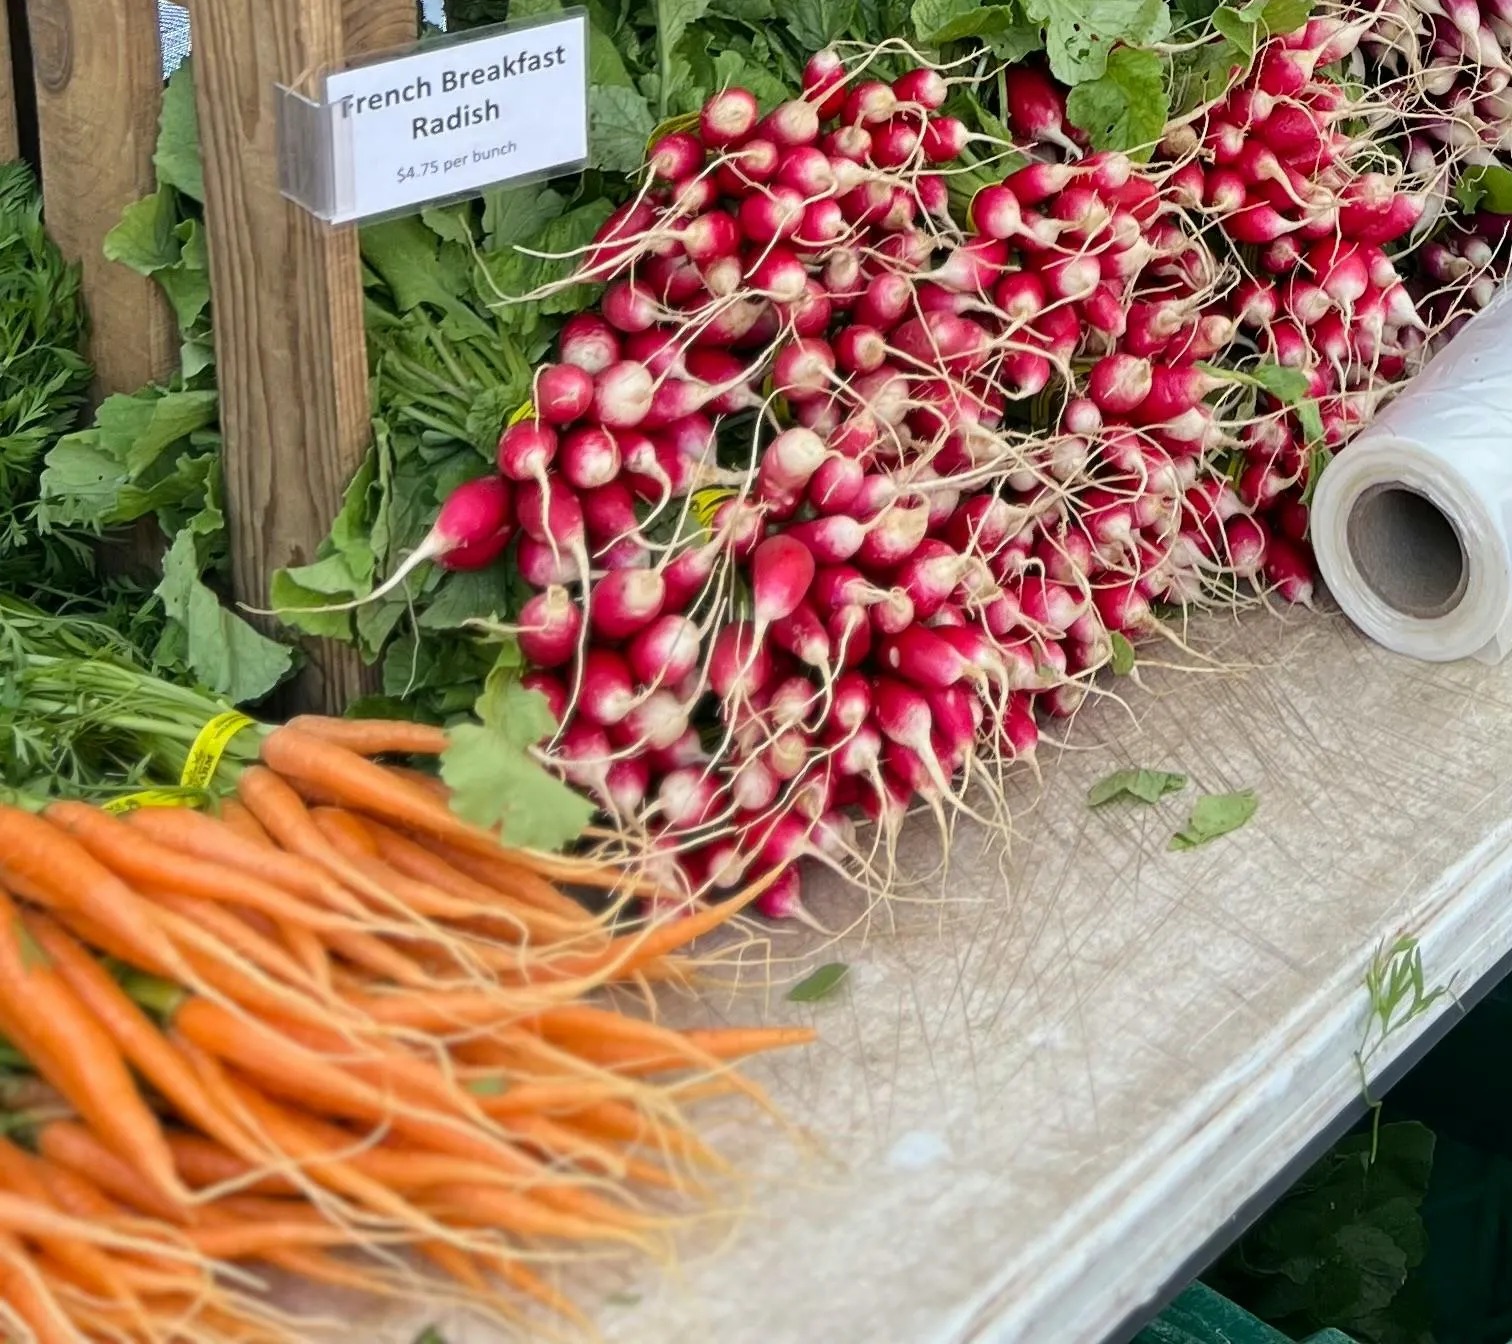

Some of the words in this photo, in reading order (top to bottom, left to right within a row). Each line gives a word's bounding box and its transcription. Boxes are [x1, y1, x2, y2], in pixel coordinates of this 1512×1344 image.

[341, 76, 431, 119] French
[441, 45, 566, 93] Breakfast
[412, 99, 500, 139] Radish
[397, 161, 439, 184] $4.75
[443, 154, 468, 174] per
[472, 140, 517, 163] bunch
